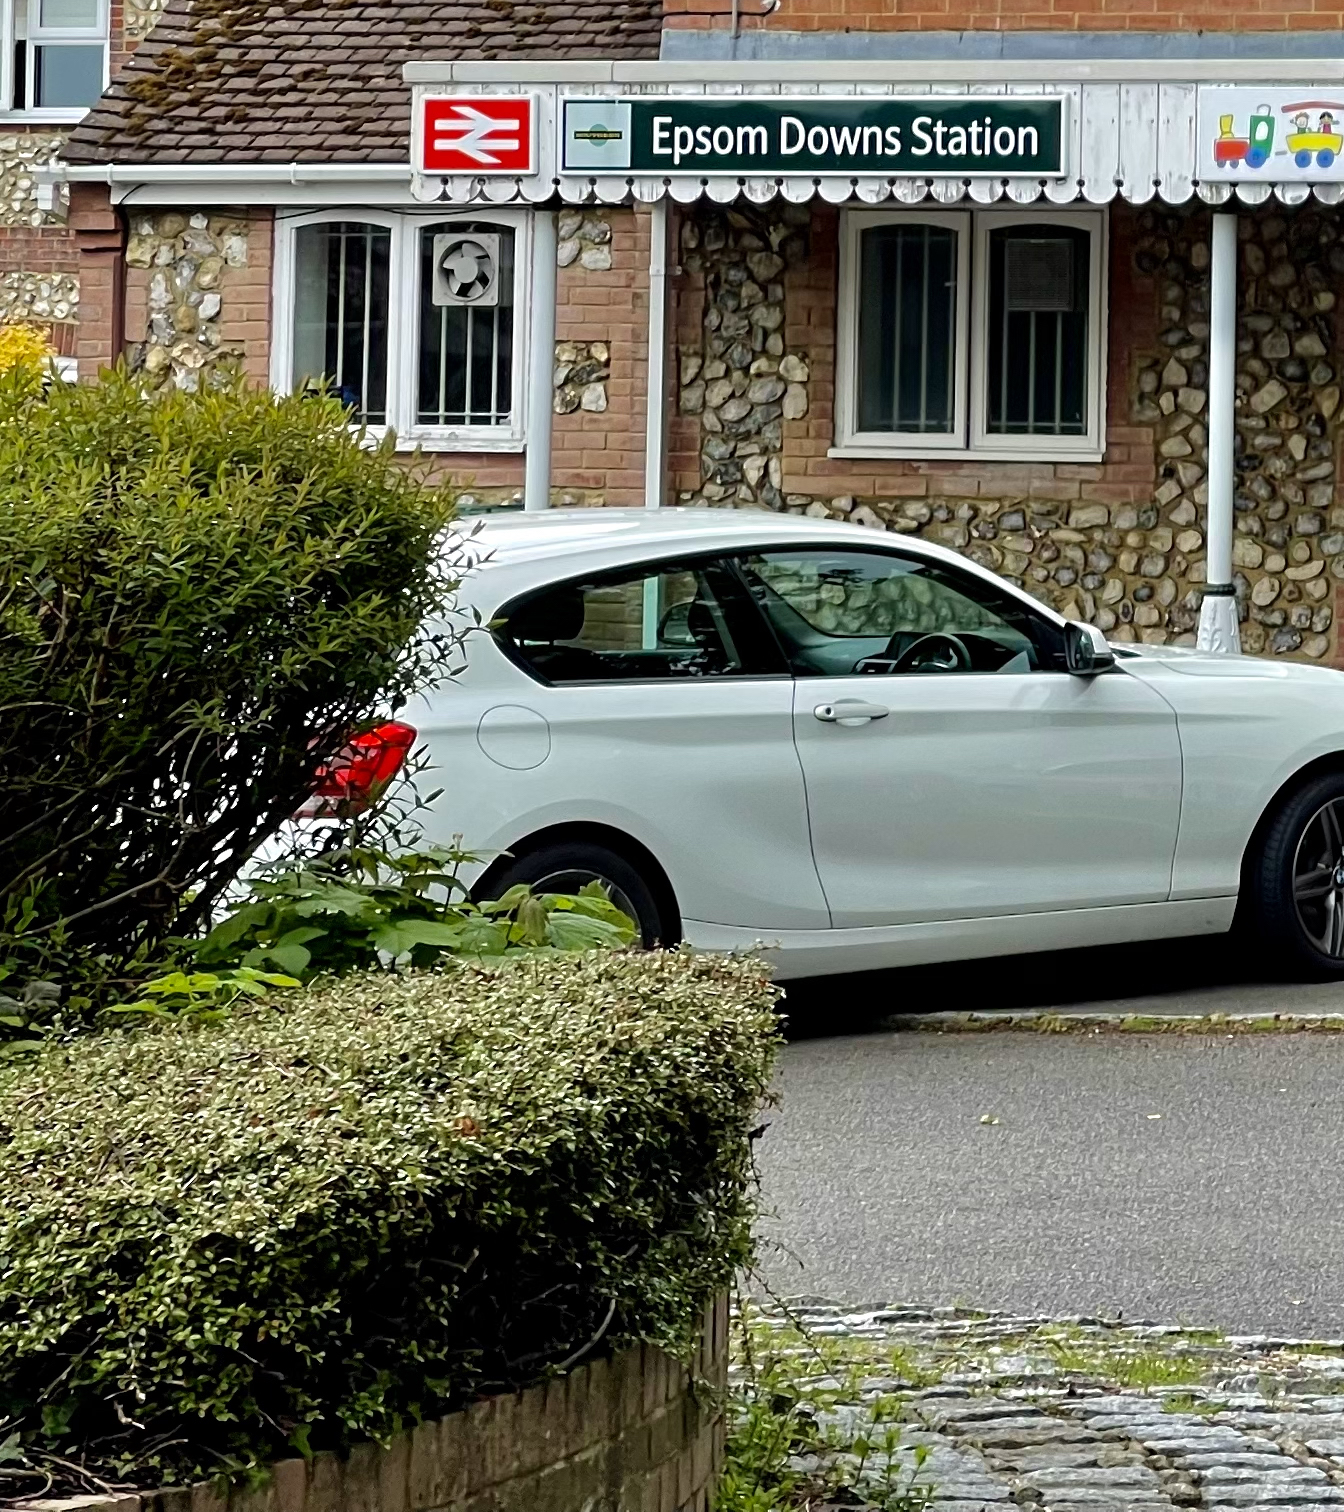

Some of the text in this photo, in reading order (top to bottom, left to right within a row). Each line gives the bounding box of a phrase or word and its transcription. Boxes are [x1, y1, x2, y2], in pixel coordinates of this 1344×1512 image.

[652, 115, 1039, 165] Epsom Downs Station
